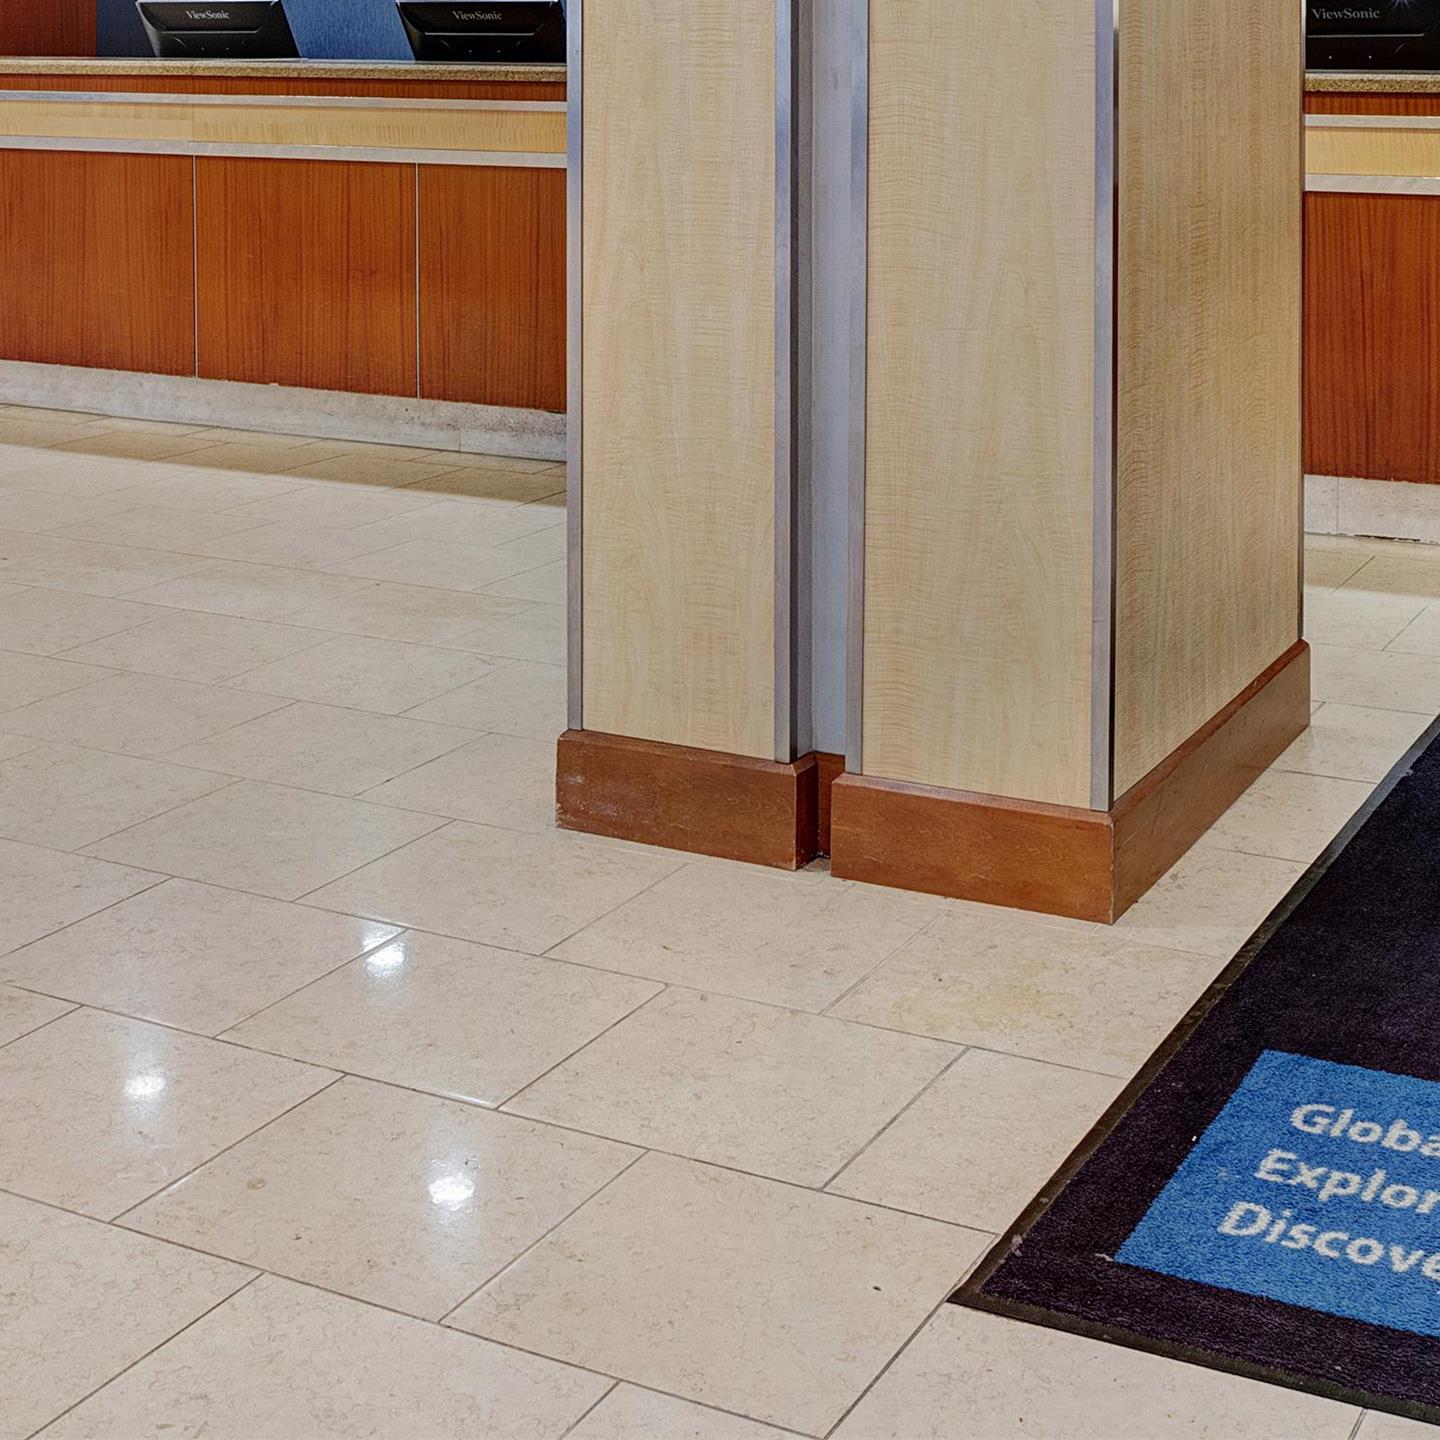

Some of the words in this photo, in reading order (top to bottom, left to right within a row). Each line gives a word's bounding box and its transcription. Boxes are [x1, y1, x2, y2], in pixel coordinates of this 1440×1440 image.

[185, 9, 230, 20] ViewSonic
[452, 10, 503, 21] ViewSonic
[1311, 7, 1381, 19] ViewSonic
